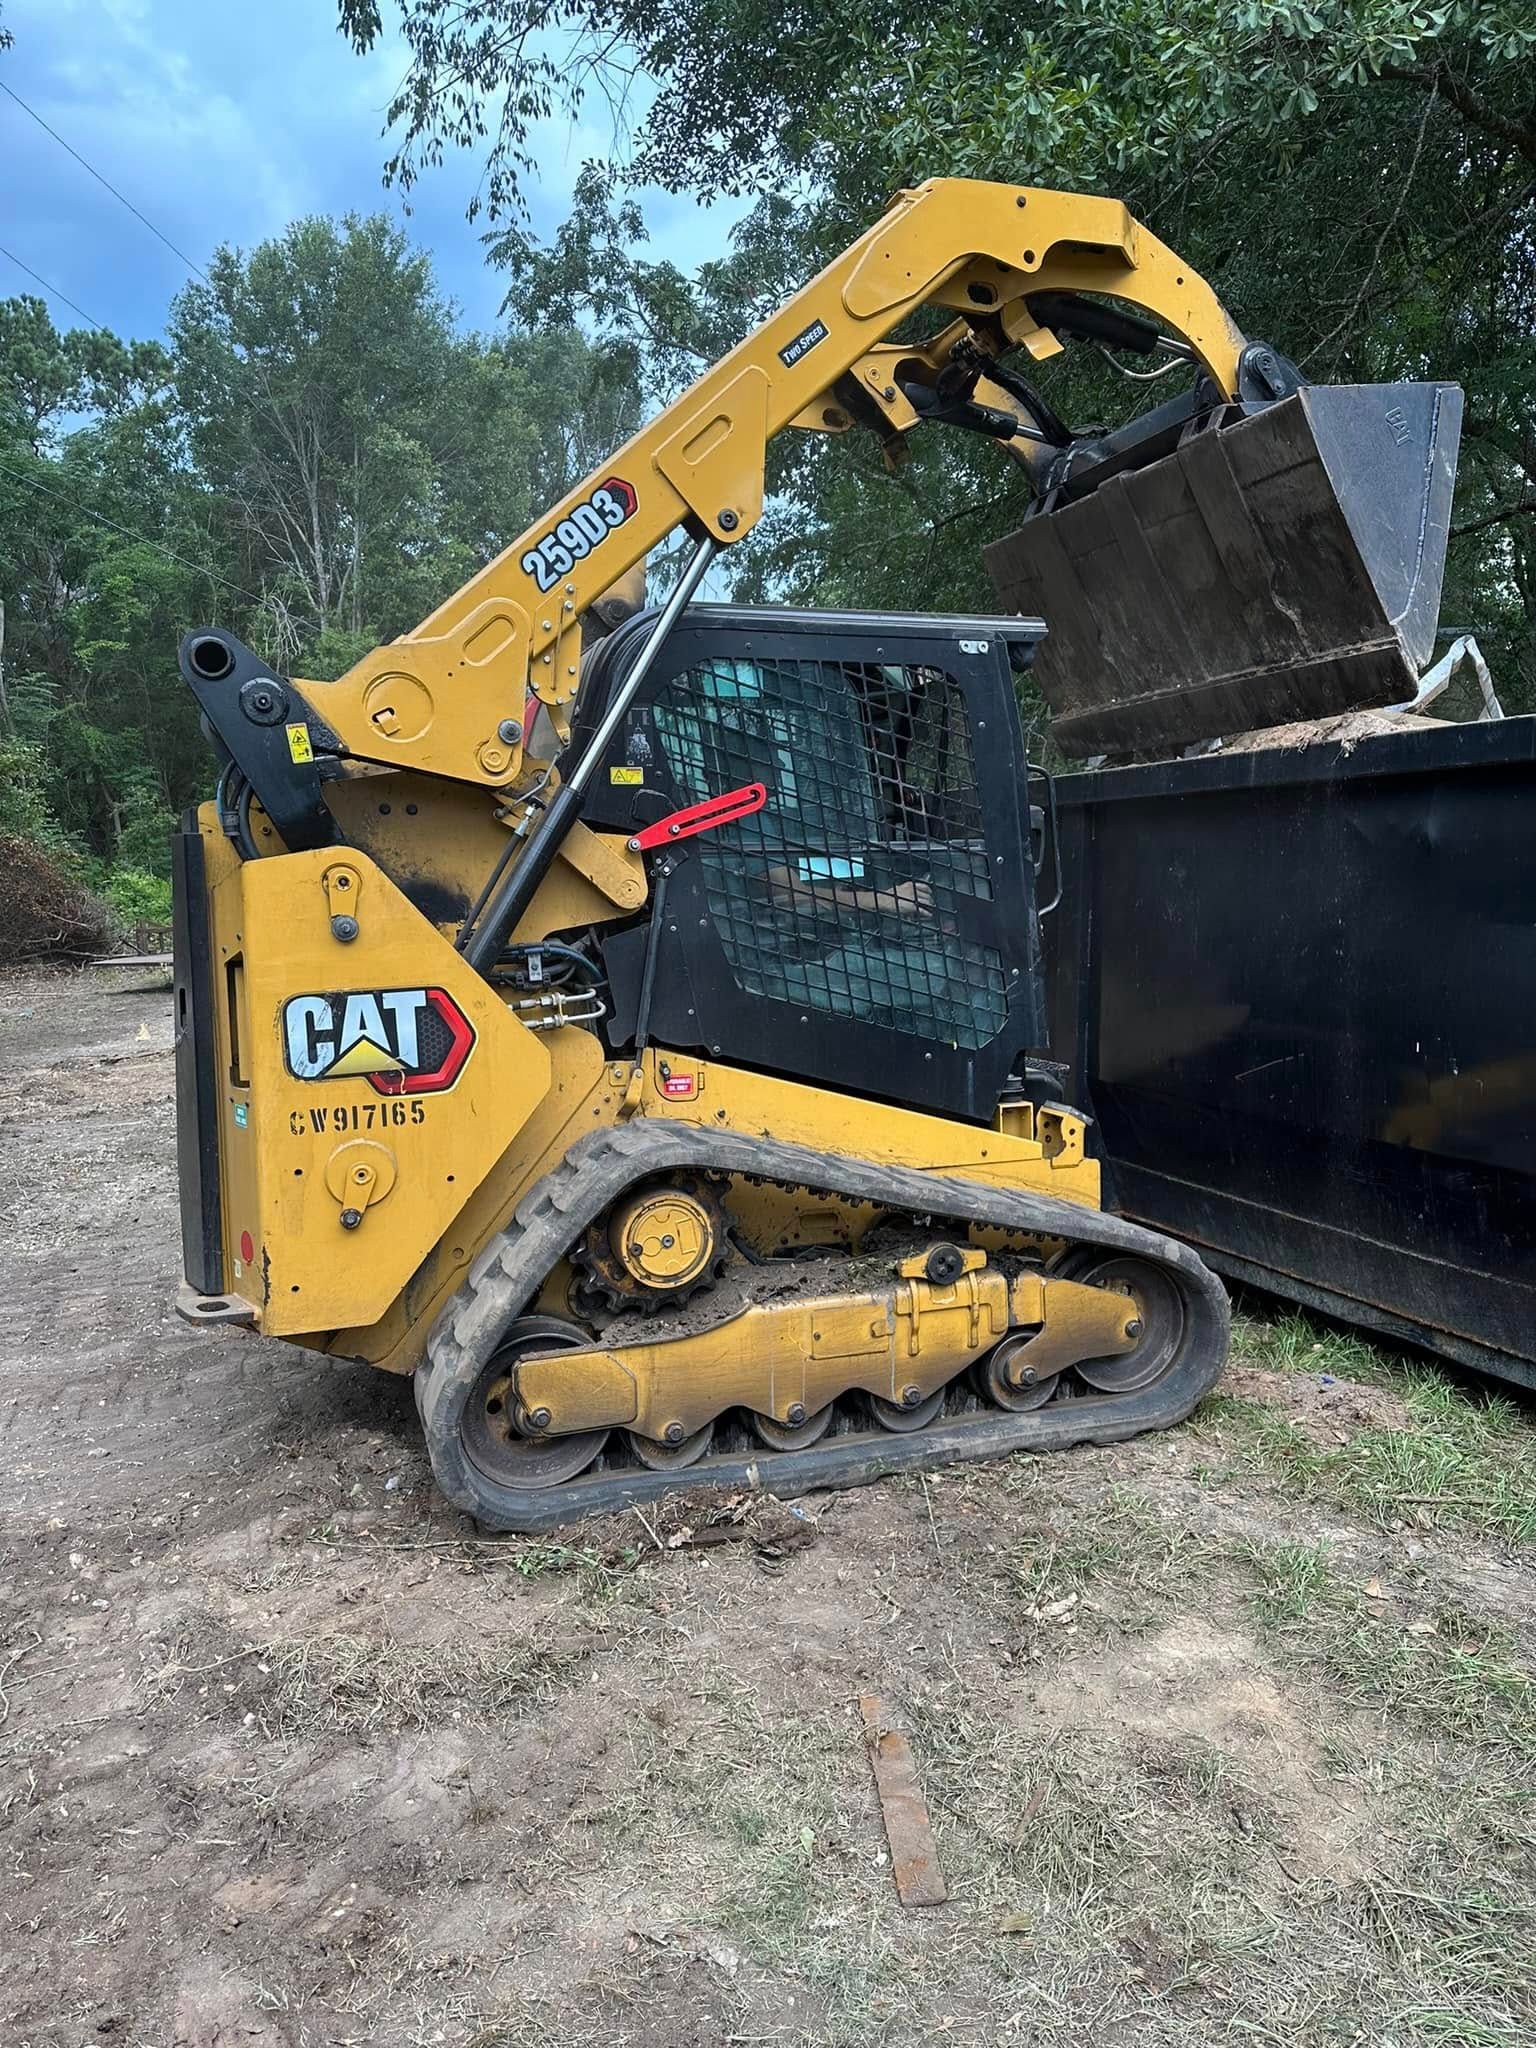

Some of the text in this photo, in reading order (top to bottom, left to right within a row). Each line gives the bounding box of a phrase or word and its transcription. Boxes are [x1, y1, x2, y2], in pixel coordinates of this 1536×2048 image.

[800, 326, 824, 349] SPEED
[1384, 406, 1413, 448] CAT
[521, 489, 626, 592] 259D3
[285, 990, 427, 1078] CAT
[289, 1100, 426, 1136] CW917165
